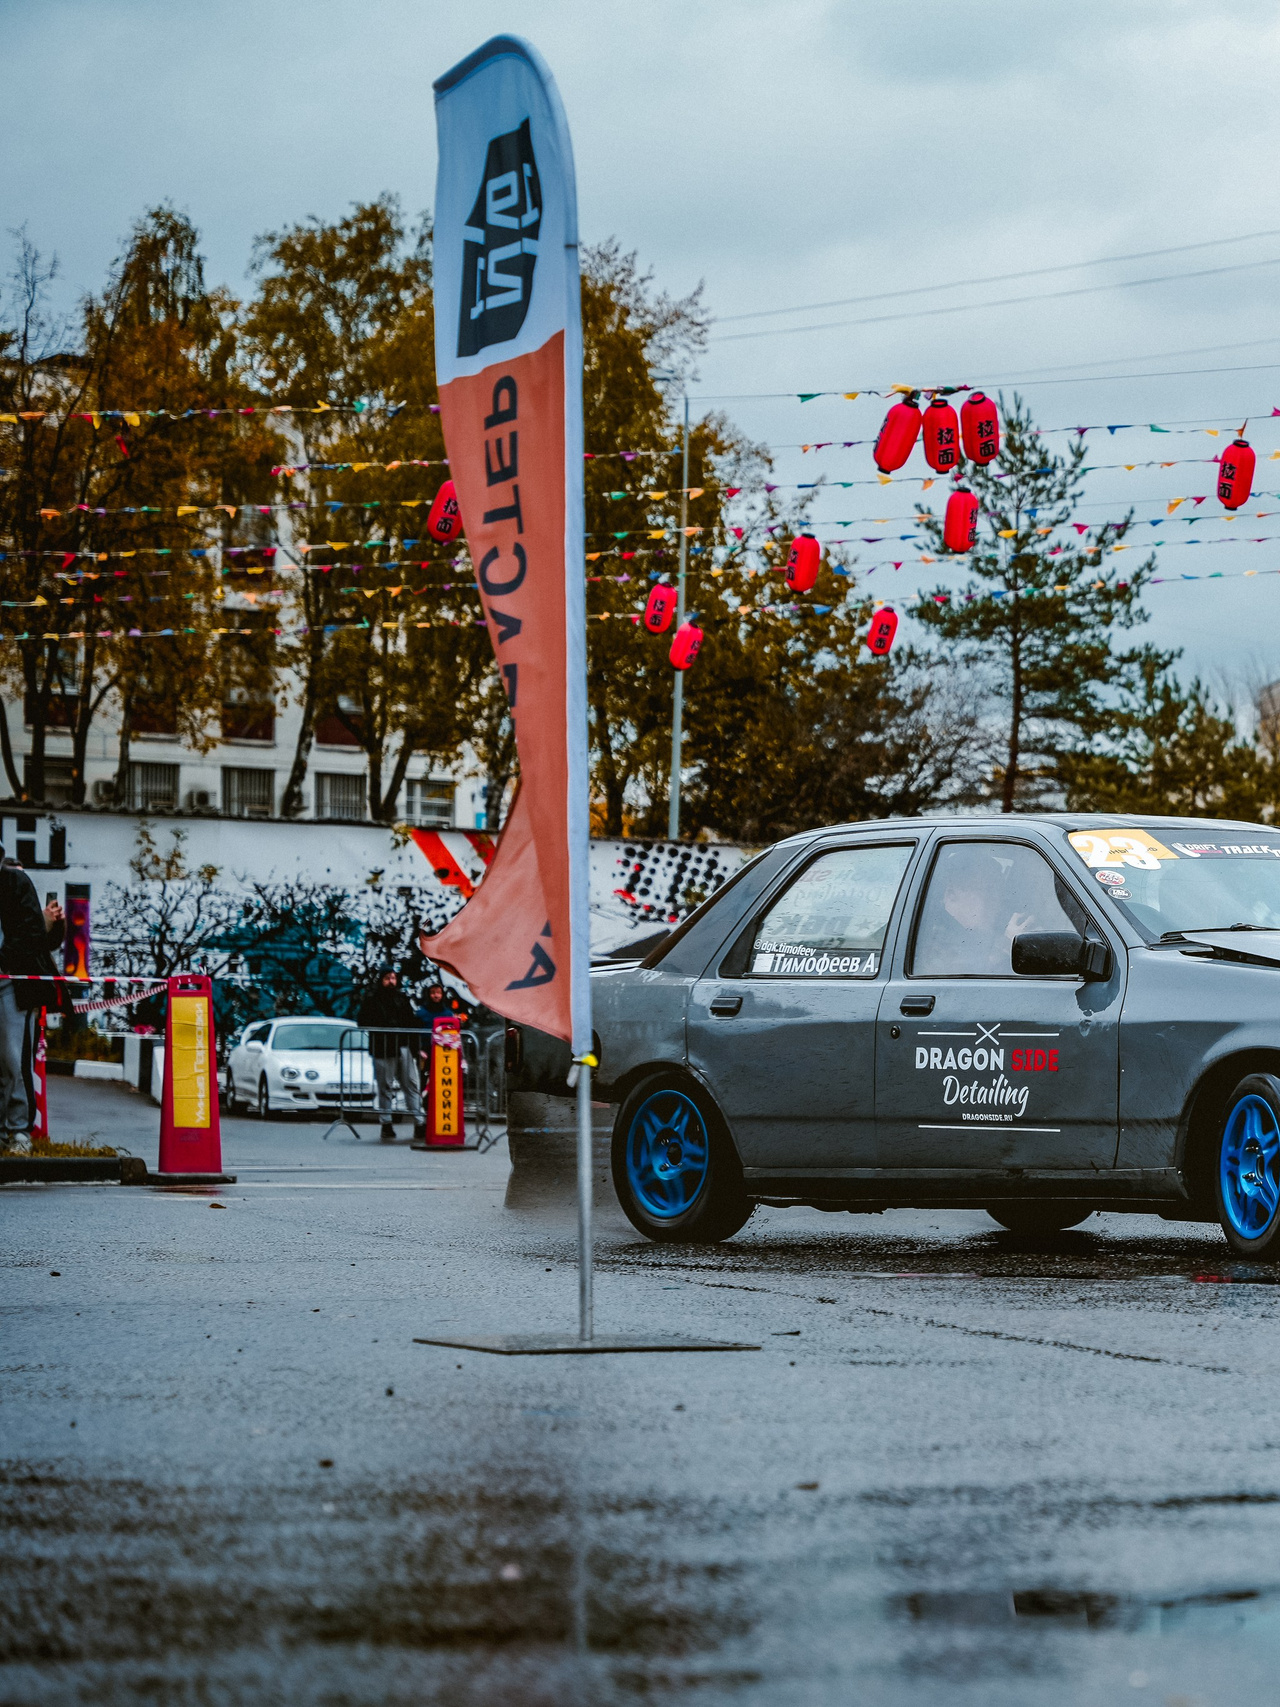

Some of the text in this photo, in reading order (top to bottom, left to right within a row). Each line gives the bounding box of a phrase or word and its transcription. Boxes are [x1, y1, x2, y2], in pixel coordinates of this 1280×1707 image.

[1070, 834, 1161, 870] 23
[773, 952, 861, 976] Тимофеев
[915, 1047, 1059, 1072] DRAGON SIDE
[942, 1073, 1029, 1117] Detailing
[962, 1113, 1013, 1121] DRAGONSIDE.RU
